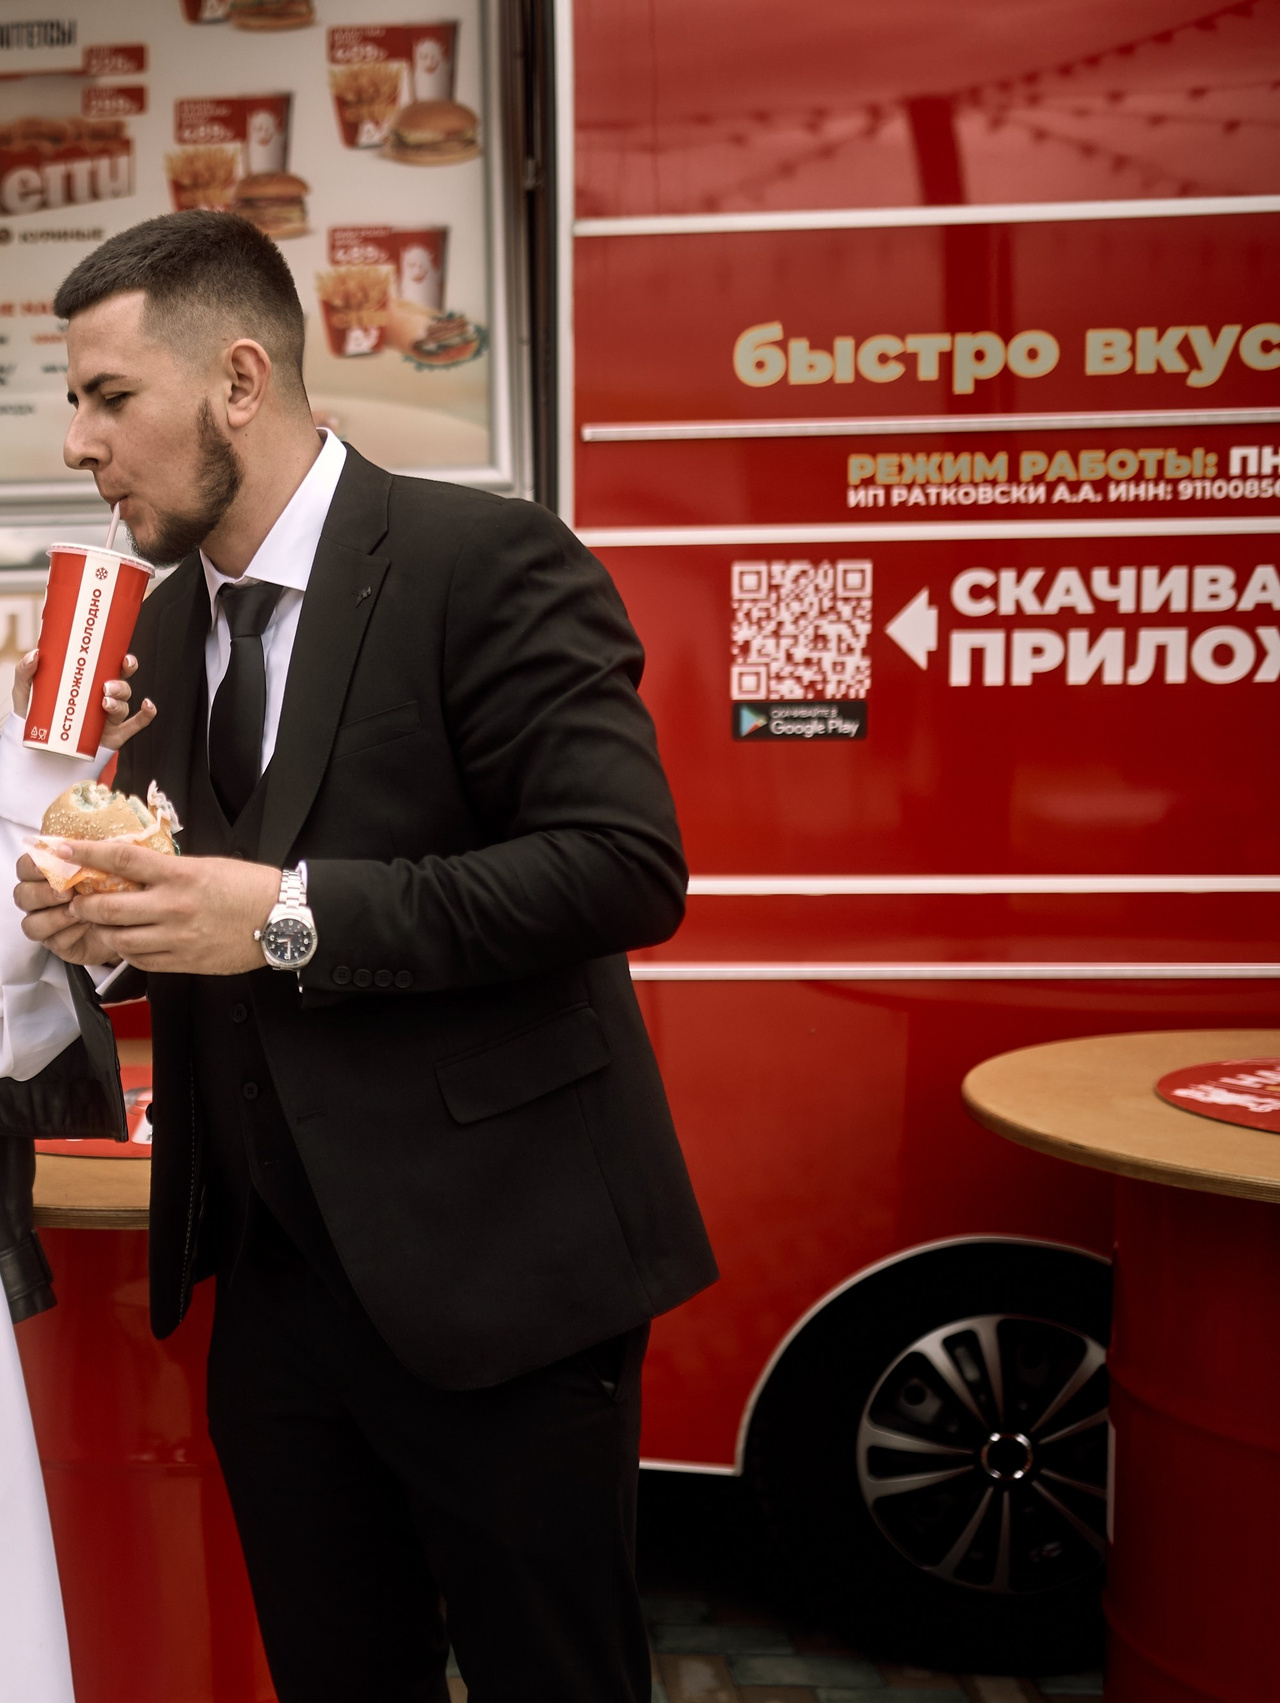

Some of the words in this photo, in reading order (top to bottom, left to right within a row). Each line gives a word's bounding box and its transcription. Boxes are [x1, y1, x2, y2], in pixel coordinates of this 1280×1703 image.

[733, 320, 1060, 395] быстро
[1084, 322, 1280, 388] вкус
[847, 452, 1008, 486] РЕЖИМ
[1020, 447, 1218, 482] РАБОТЫ:
[847, 485, 886, 508] ИП
[890, 482, 1047, 507] РАТКОВСКИ
[1051, 482, 1103, 504] А.А.
[1108, 481, 1173, 503] ИНН:
[949, 564, 1280, 617] СКАЧИВА
[60, 657, 87, 741] ОСТОРОЖНО
[79, 588, 102, 655] ХОЛОДНО
[770, 719, 826, 739] Google
[827, 718, 860, 738] Play
